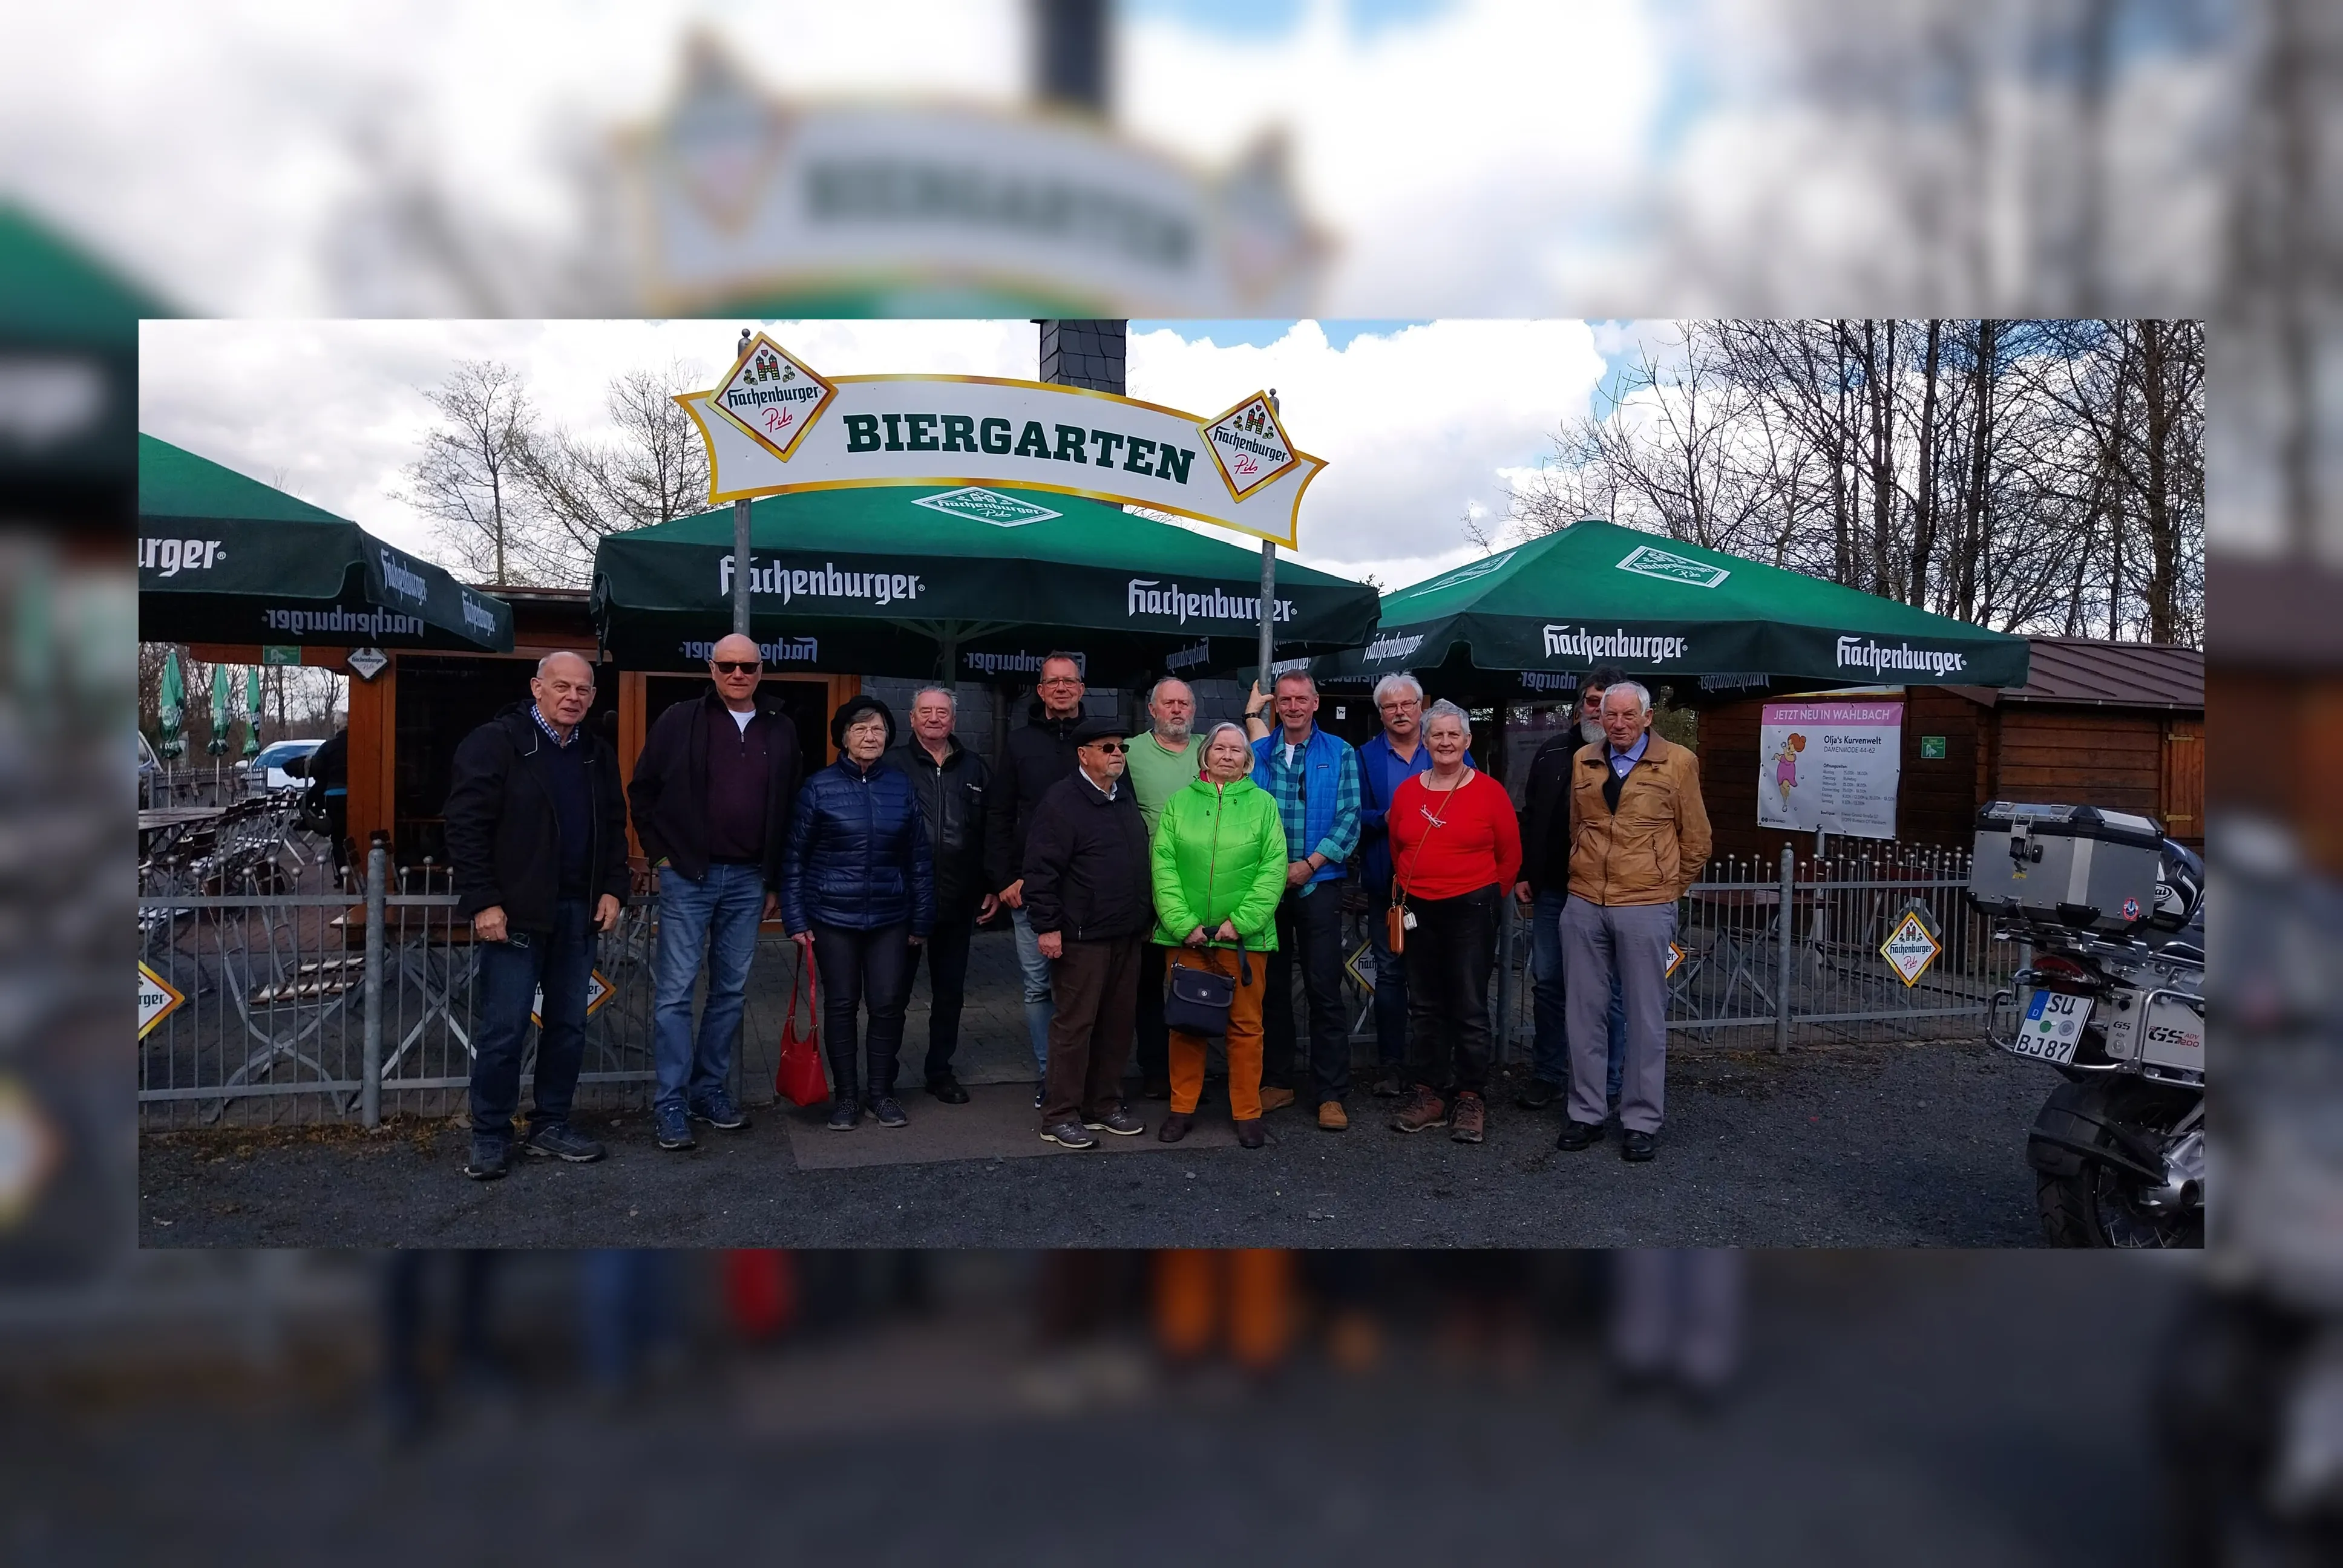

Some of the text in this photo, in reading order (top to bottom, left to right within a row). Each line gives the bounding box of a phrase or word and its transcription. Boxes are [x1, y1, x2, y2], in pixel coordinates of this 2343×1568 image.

[726, 386, 819, 410] Hachenburger
[761, 407, 793, 433] Pils
[843, 413, 1196, 485] BIERGARTEN
[1213, 425, 1288, 463] Hachenburger
[1233, 454, 1259, 474] Pils
[1543, 624, 1685, 665] Hachenburger
[1837, 635, 1962, 677] Hachenburger
[1774, 709, 1890, 720] JETZT NEU IN WAHLBACH
[1844, 736, 1882, 745] Kurvenwelt
[1890, 943, 1932, 956] Hachenburger
[2031, 1008, 2039, 1017] D
[2047, 994, 2076, 1016] SU
[2113, 1021, 2132, 1031] GS
